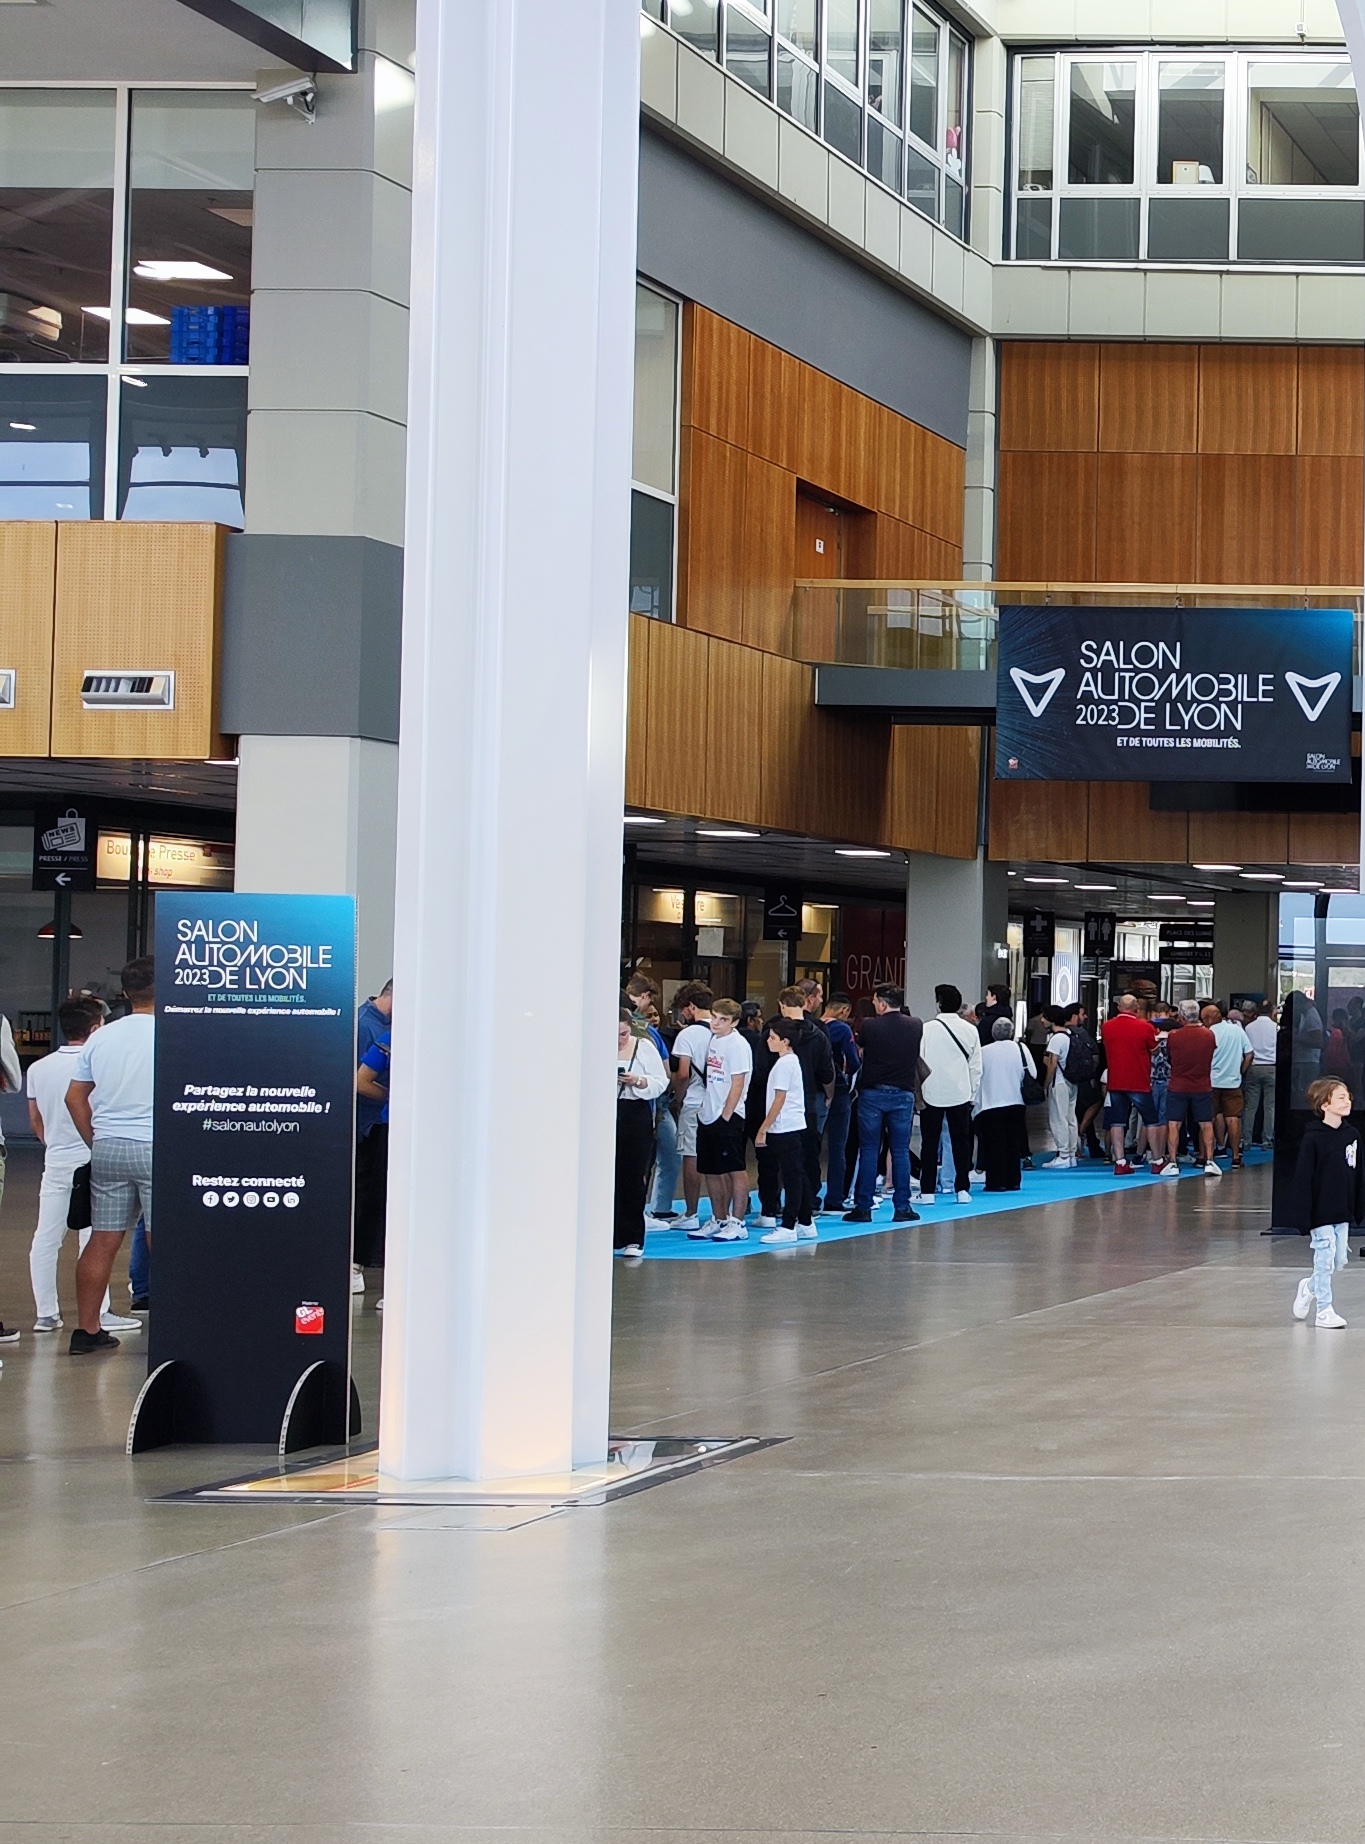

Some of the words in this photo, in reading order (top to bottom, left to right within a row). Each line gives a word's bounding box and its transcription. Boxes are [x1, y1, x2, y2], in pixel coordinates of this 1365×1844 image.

[1079, 640, 1181, 669] SALON
[1076, 671, 1274, 702] AUTOMOBILE
[1165, 702, 1242, 730] LYON
[1117, 737, 1128, 747] ET
[1129, 737, 1140, 747] DE
[1142, 737, 1174, 748] TOUTES
[1176, 737, 1191, 748] LES
[1193, 735, 1241, 749] MOBILITÉS.
[49, 825, 76, 838] NEWS
[159, 845, 196, 861] Presse
[154, 865, 173, 879] shop
[177, 919, 258, 942] SALON
[175, 943, 332, 968] AUTOMOBILE
[245, 967, 307, 990] LYON
[208, 993, 217, 1001] ET
[218, 993, 226, 1002] DE
[227, 994, 253, 1002] TOUTES
[255, 994, 267, 1002] LES
[204, 1006, 212, 1014] la
[212, 1006, 246, 1015] nouvelle
[247, 1006, 291, 1016] expérience
[292, 1008, 336, 1016] automobile
[184, 1084, 245, 1098] Partagez
[245, 1085, 258, 1097] la
[260, 1086, 316, 1097] nouvelle
[172, 1100, 246, 1113] expérience
[248, 1101, 322, 1113] automobile
[202, 1118, 300, 1134] #salonautolyon
[192, 1175, 240, 1187] Restez
[241, 1175, 305, 1187] connecté
